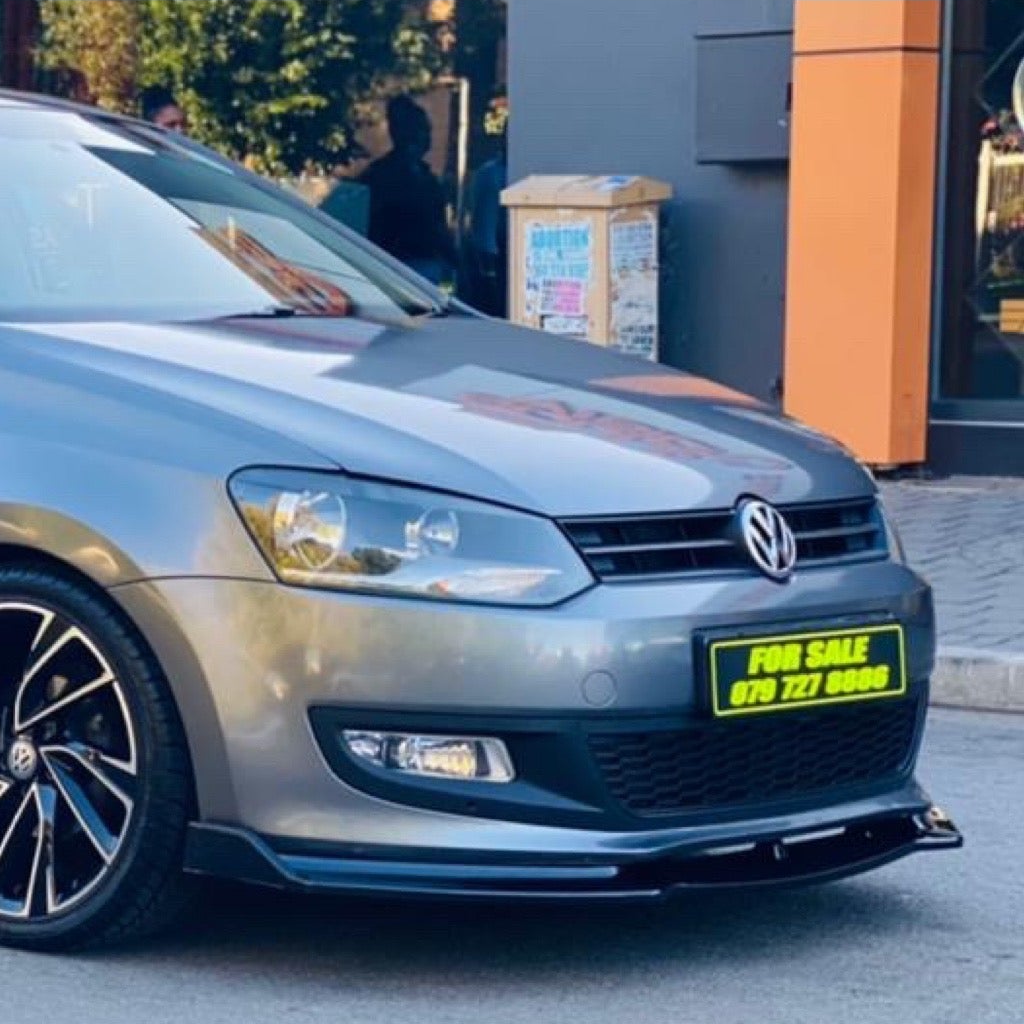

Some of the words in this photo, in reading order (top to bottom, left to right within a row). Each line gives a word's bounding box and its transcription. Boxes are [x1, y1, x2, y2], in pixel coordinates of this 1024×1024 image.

[747, 643, 802, 675] FOR
[805, 635, 870, 669] SALE
[781, 673, 823, 701] 727
